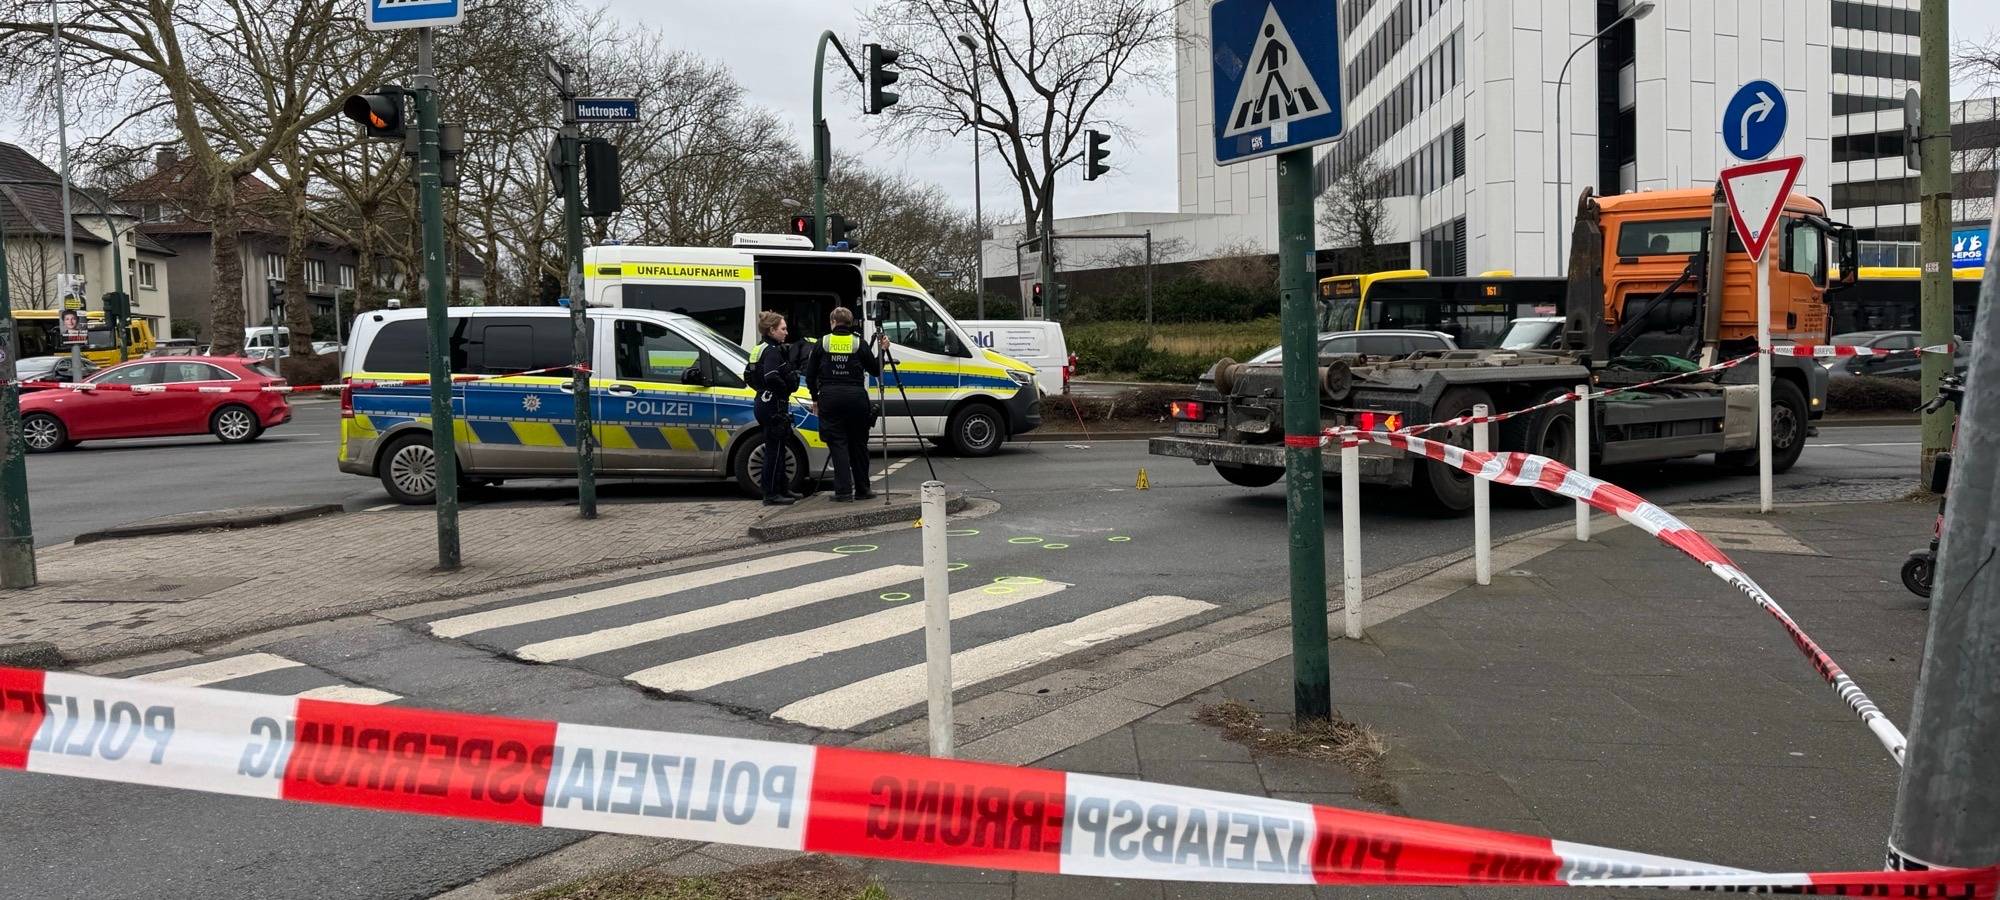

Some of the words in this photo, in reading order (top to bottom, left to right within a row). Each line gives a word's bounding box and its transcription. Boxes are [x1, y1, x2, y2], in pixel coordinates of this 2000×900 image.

[578, 104, 631, 118] Huttropstr.
[1280, 161, 1287, 176] 5
[637, 266, 740, 278] UNFALLAUFNAHME
[830, 343, 852, 352] POLIZEI
[831, 354, 849, 362] NRW
[625, 400, 693, 417] POLIZEI
